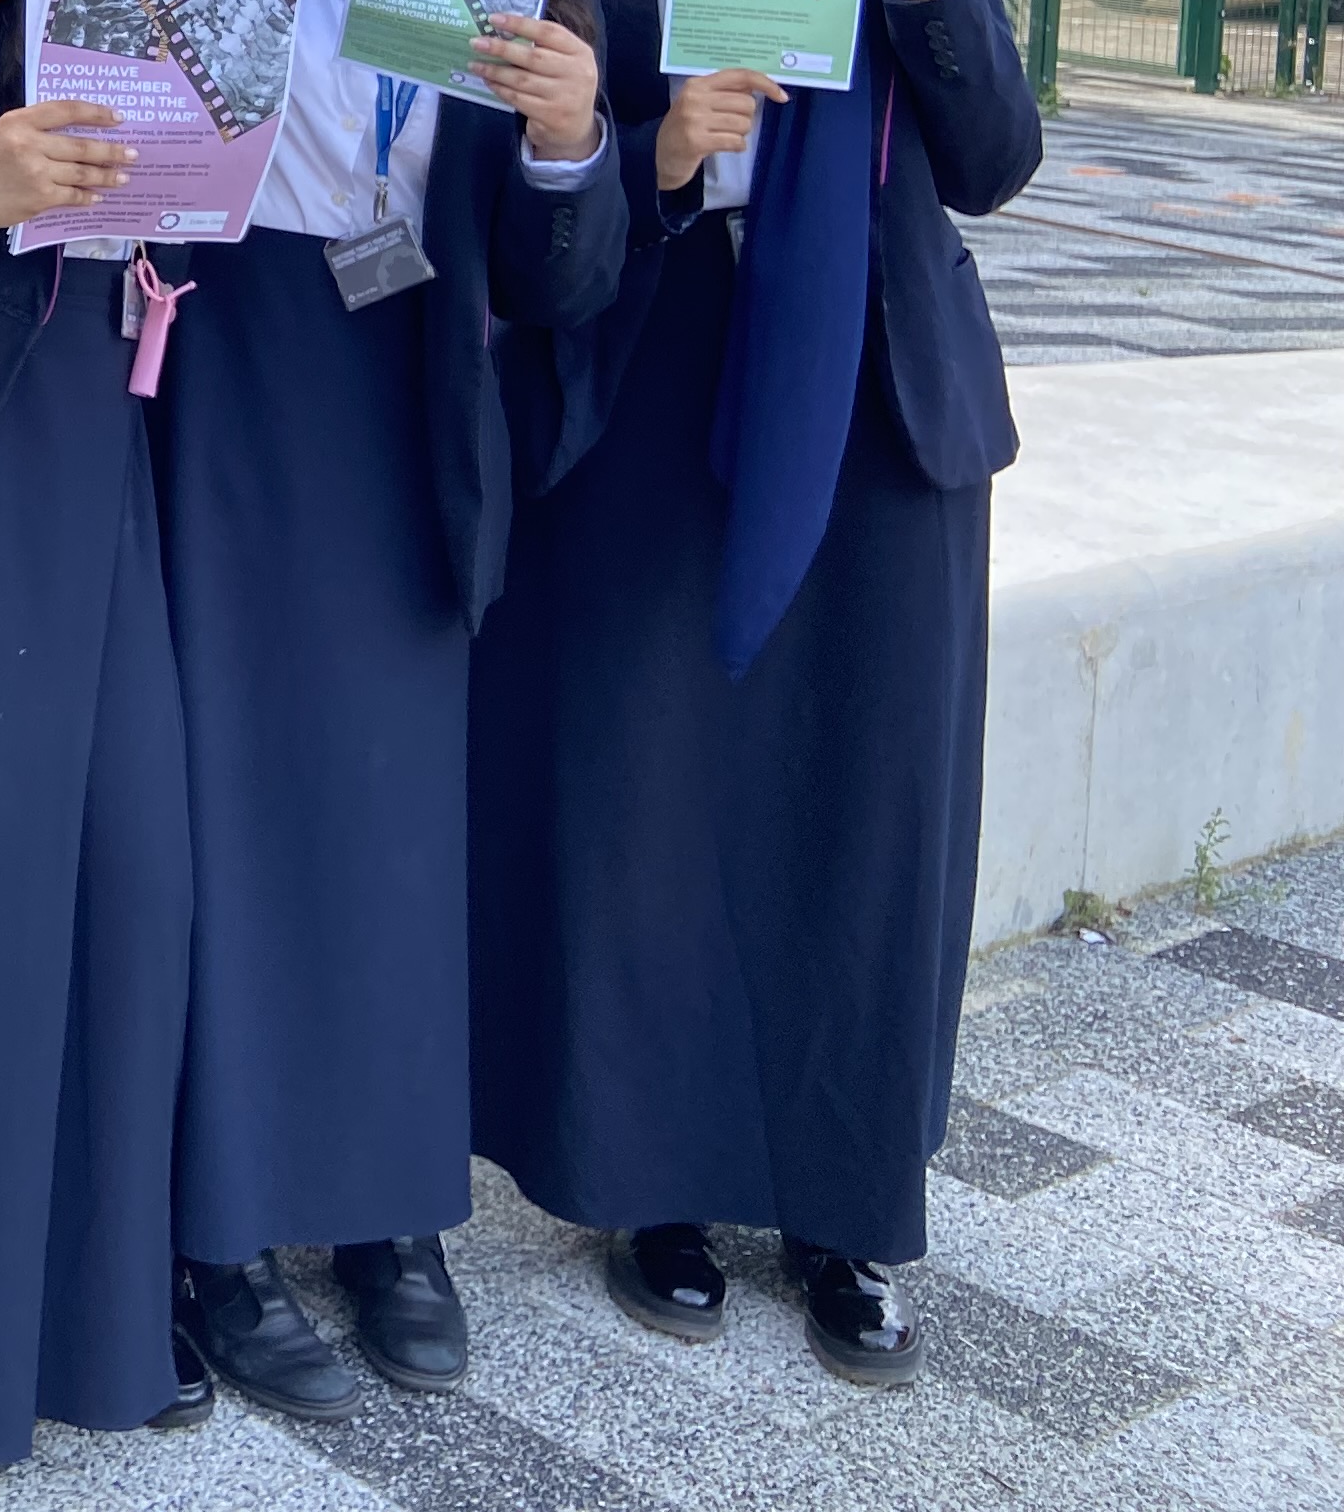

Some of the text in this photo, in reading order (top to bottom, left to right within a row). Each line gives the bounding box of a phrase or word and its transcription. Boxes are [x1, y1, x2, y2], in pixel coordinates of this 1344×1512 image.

[40, 63, 139, 77] DO YOU HAVE
[39, 78, 171, 93] A FAMILY MEMBER
[141, 96, 154, 107] IN
[158, 96, 186, 108] THE
[158, 111, 199, 123] WAR?
